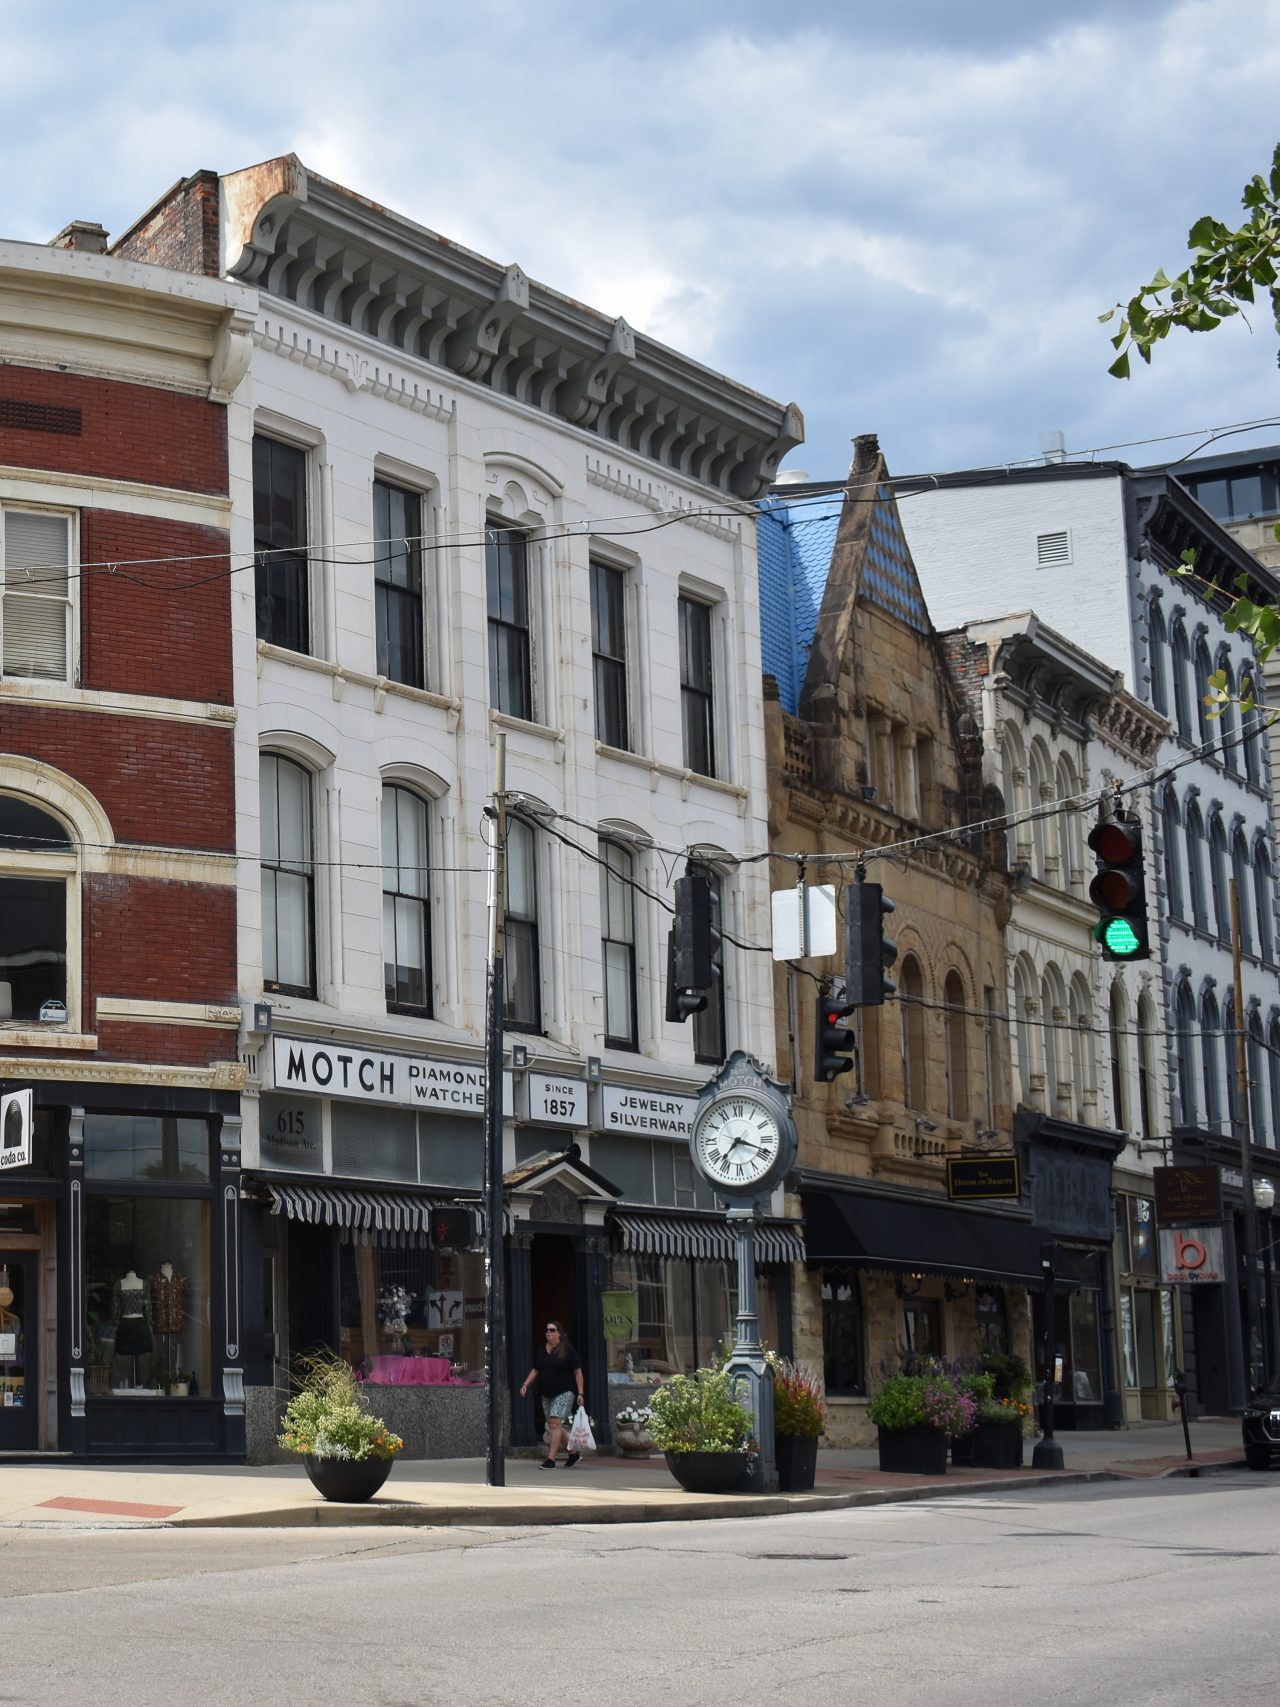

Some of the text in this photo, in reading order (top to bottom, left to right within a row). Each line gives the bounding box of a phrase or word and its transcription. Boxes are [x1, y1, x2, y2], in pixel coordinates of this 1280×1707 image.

[287, 1046, 394, 1095] MOTCH
[409, 1065, 487, 1087] DIAMOND
[544, 1084, 574, 1095] SINCE
[719, 1076, 762, 1088] MOTCH
[415, 1085, 486, 1106] WATCHE
[543, 1098, 576, 1117] 1857
[619, 1096, 684, 1116] JEWELRY
[277, 1109, 305, 1135] 615
[610, 1112, 693, 1134] SILVERWARE
[0, 1151, 26, 1166] coda co.
[1174, 1231, 1207, 1270] b
[605, 1315, 633, 1325] OPEN
